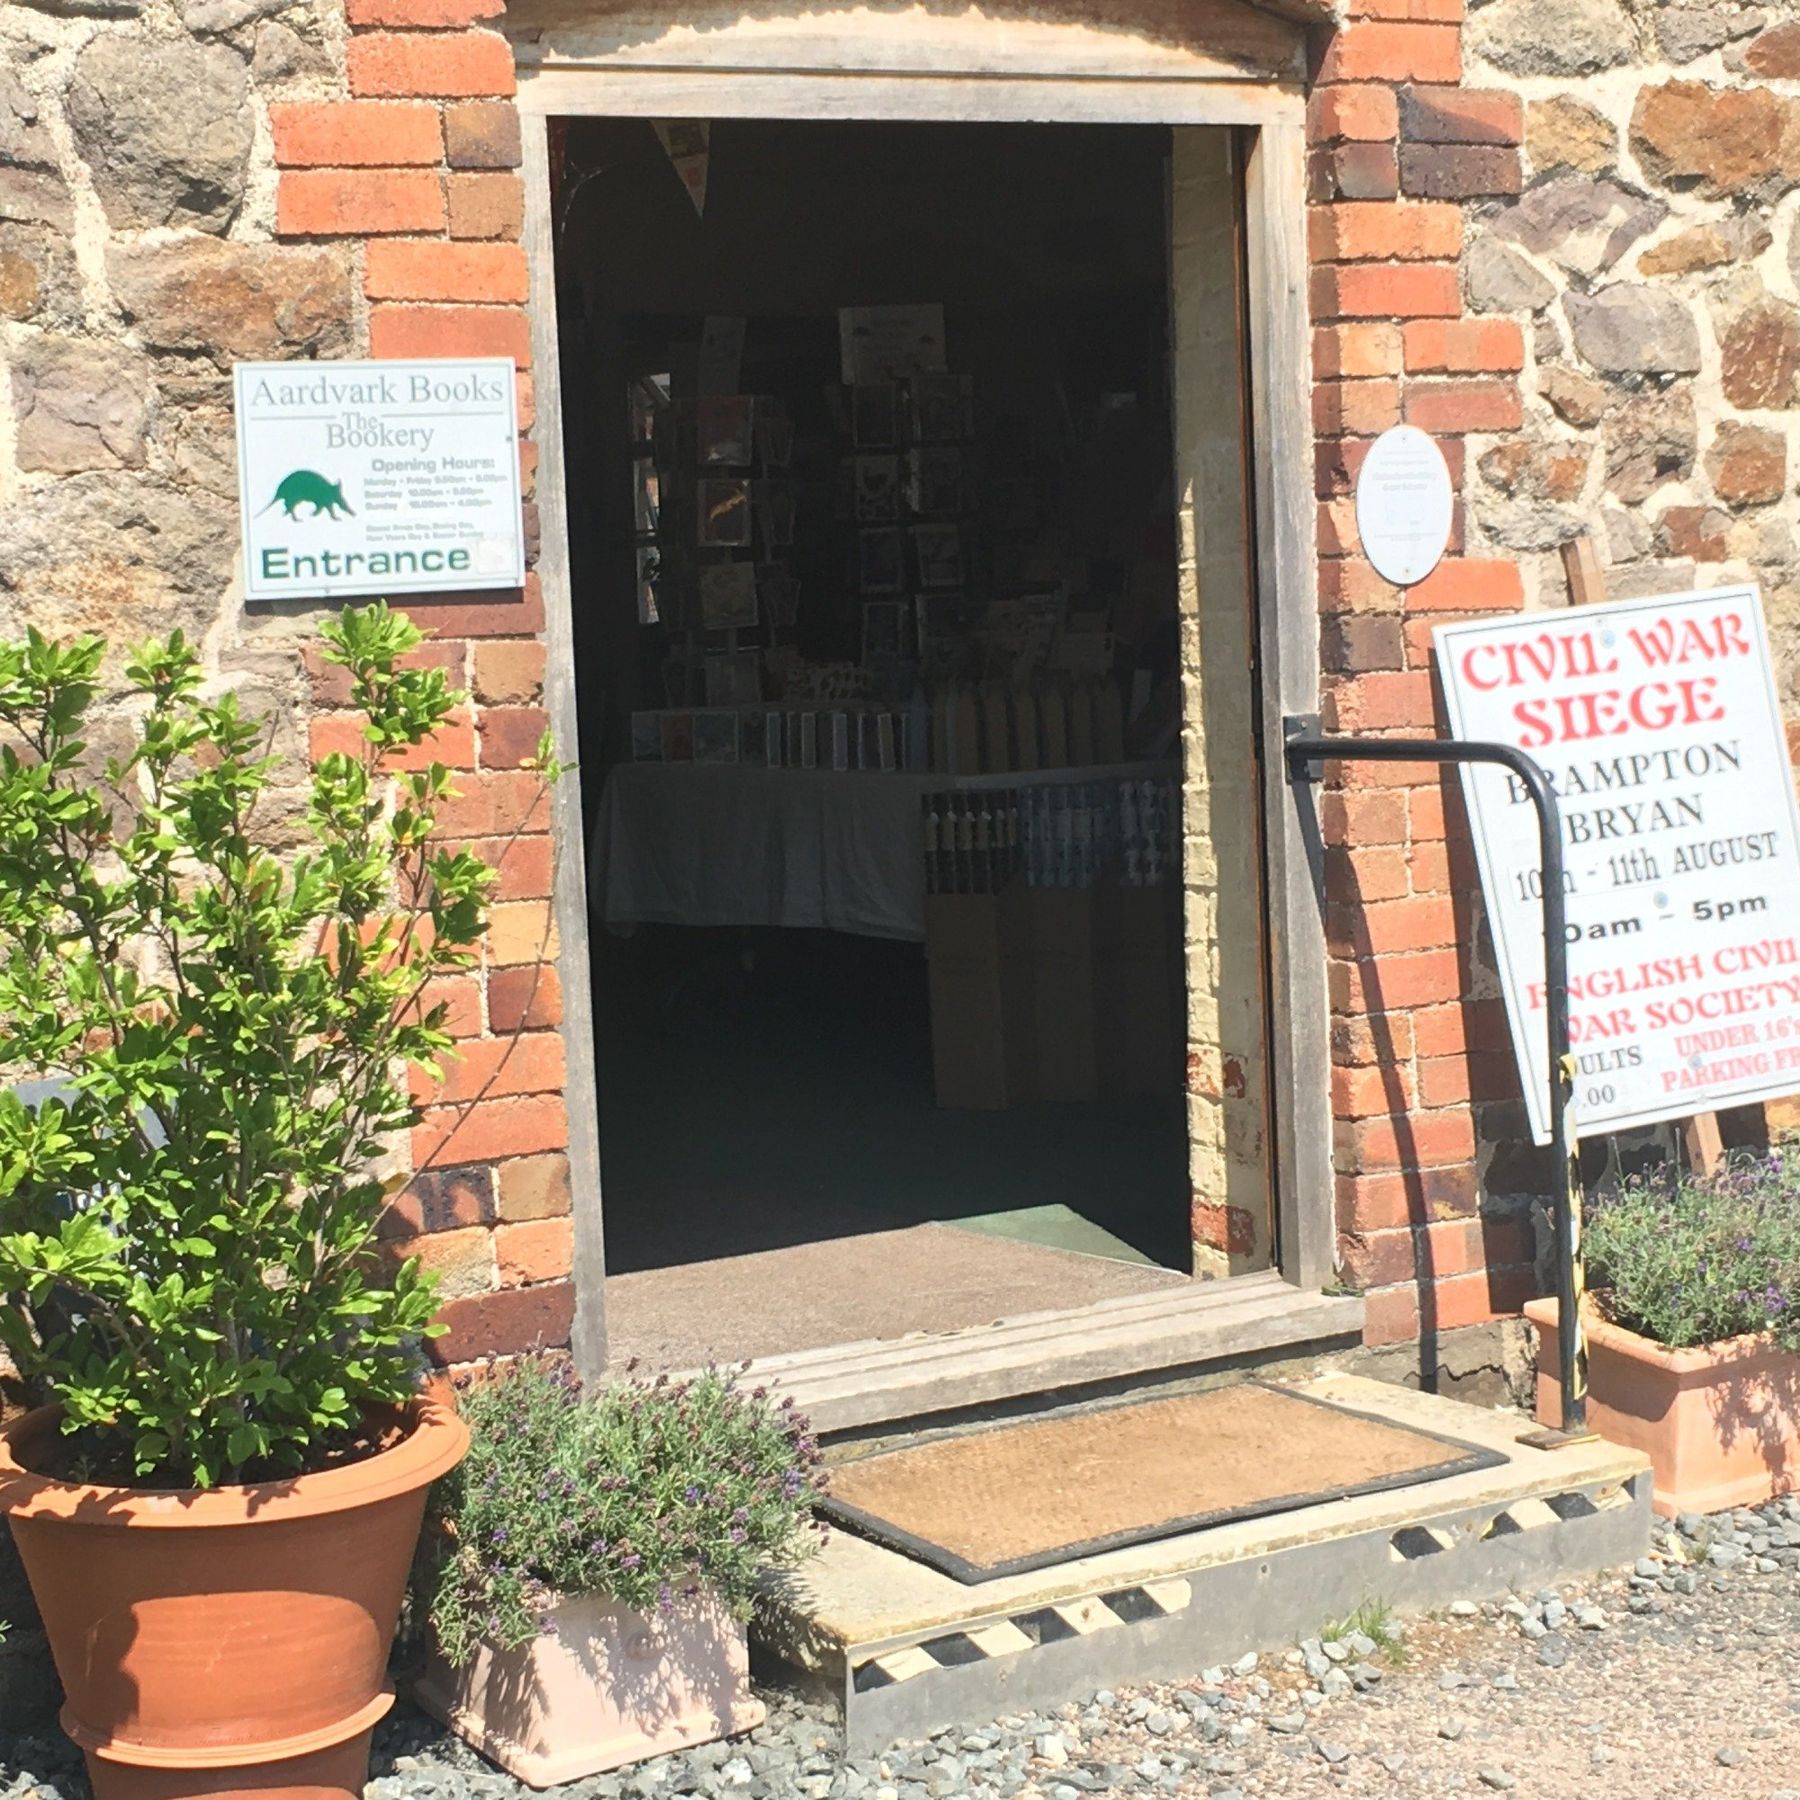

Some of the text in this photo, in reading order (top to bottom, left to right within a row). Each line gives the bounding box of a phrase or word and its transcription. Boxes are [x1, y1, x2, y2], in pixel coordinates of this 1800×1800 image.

[250, 373, 504, 407] Aardvark Books
[326, 422, 435, 452] Bookery
[341, 411, 379, 431] The
[371, 456, 496, 475] Opening Hours:
[261, 546, 471, 580] Entrance
[1461, 613, 1751, 692] CIVIL WAR
[1512, 676, 1726, 749] SIEGE
[1565, 793, 1706, 845] BRYAN
[1515, 868, 1578, 902] 10h
[1608, 847, 1661, 887] 11th
[1673, 831, 1780, 875] AUGUST
[1542, 914, 1644, 944] 0am
[1692, 893, 1768, 923] 5pm
[1673, 1022, 1761, 1059] UNDER
[1660, 1051, 1771, 1093] PARKING
